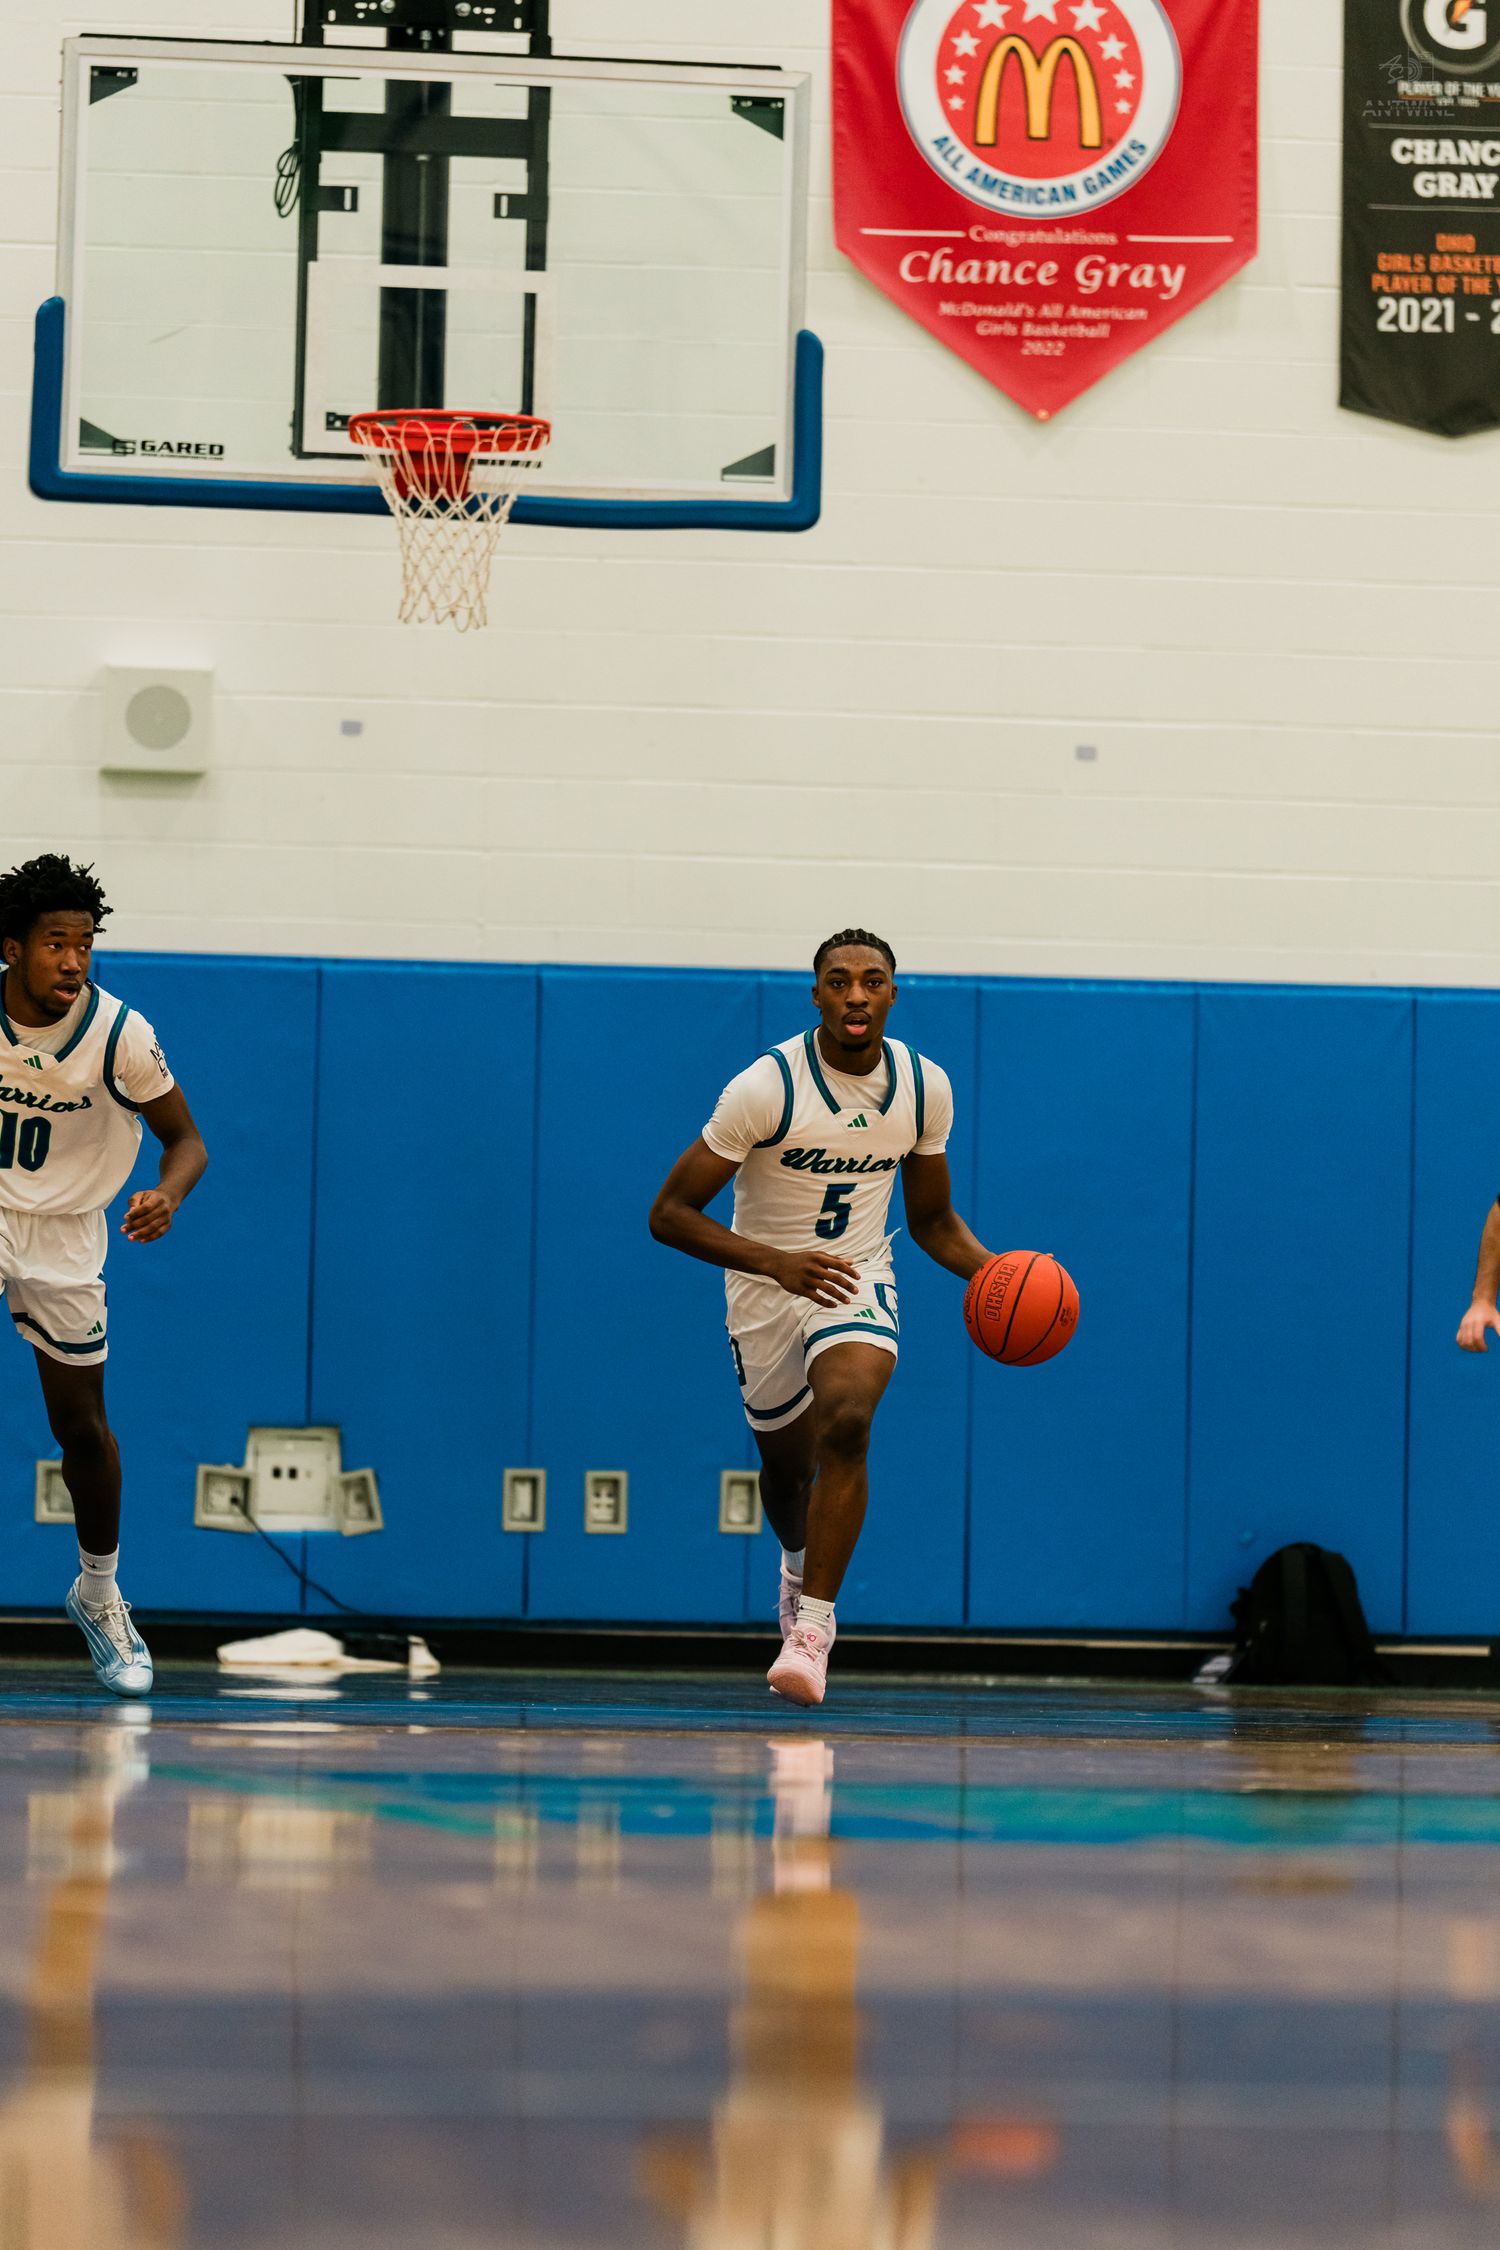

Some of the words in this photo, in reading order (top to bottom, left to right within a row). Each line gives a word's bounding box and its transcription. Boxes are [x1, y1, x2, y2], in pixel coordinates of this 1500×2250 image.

[933, 136, 960, 171] ALL
[966, 167, 1077, 205] AMERICAN
[1084, 138, 1147, 195] GAMES
[1413, 171, 1499, 199] GRAY
[968, 225, 1118, 248] Congratulations
[900, 247, 1059, 286] Chance
[1074, 253, 1186, 300] Gray
[1371, 273, 1433, 294] PLAYER
[1436, 274, 1457, 294] OF
[1462, 276, 1493, 296] THE
[939, 301, 1035, 318] McDonald's
[1038, 303, 1064, 318] All
[1065, 305, 1149, 320] American
[1376, 296, 1455, 333] 2021
[975, 320, 1018, 337] Girls
[1021, 322, 1111, 338] Basketball
[1021, 340, 1066, 356] 2022
[140, 440, 225, 456] GARED
[0, 1109, 52, 1172] 10
[815, 1182, 858, 1240] 5
[984, 1263, 1019, 1322] OHSAA
